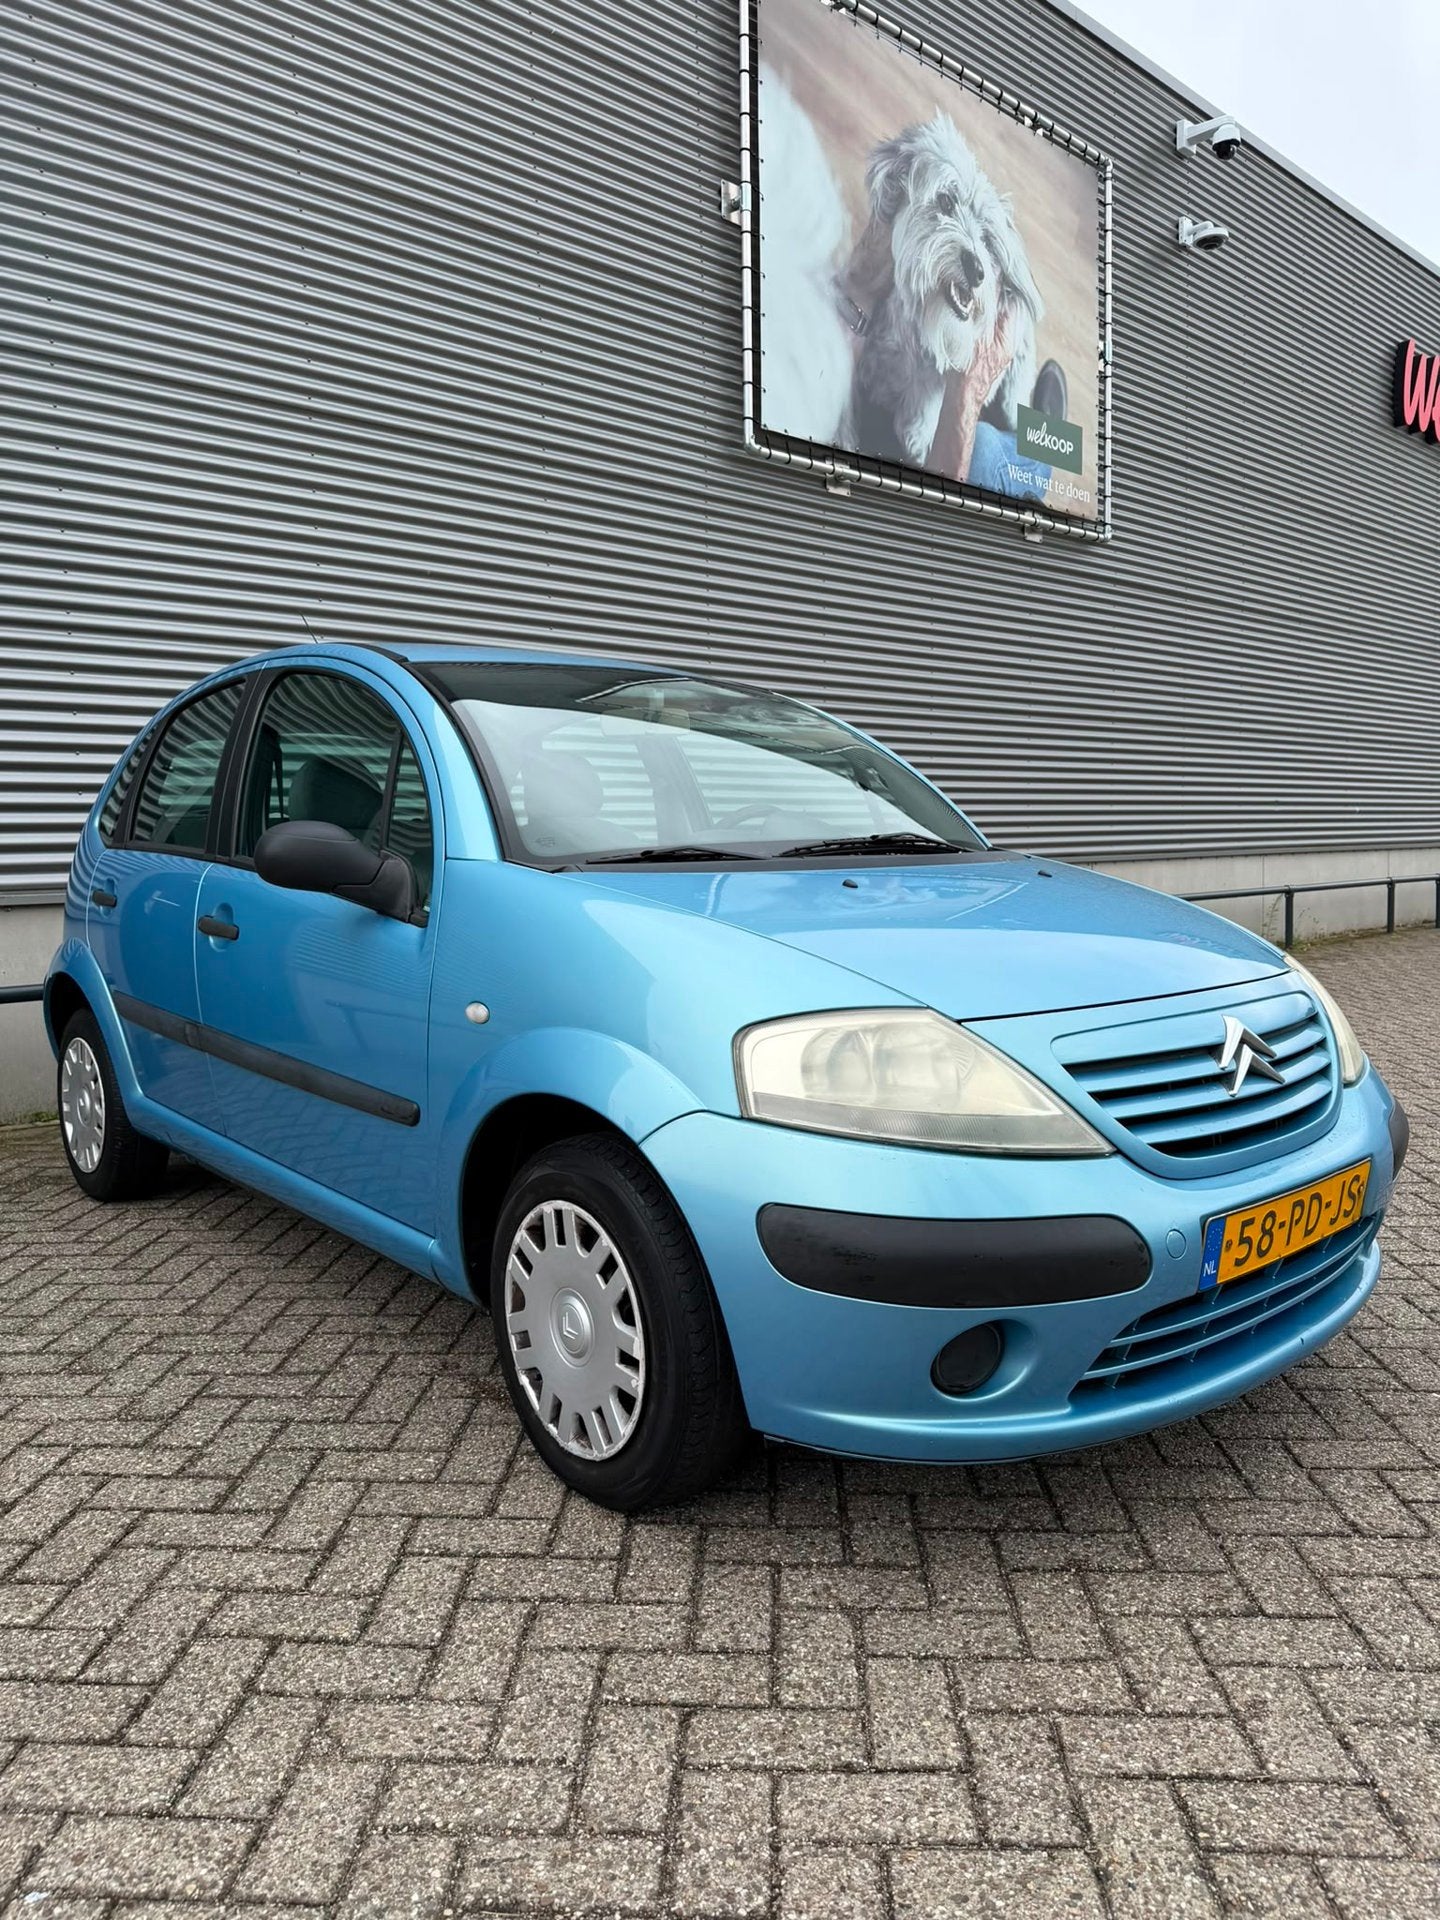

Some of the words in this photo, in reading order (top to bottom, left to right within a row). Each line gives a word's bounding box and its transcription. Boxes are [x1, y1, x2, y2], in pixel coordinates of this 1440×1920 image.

[1007, 463, 1033, 485] Weet
[1035, 474, 1053, 492] wat
[1054, 480, 1064, 495] te
[1066, 482, 1091, 503] doen
[1233, 1173, 1361, 1268] 58-PD-JS
[1203, 1259, 1217, 1277] NL
